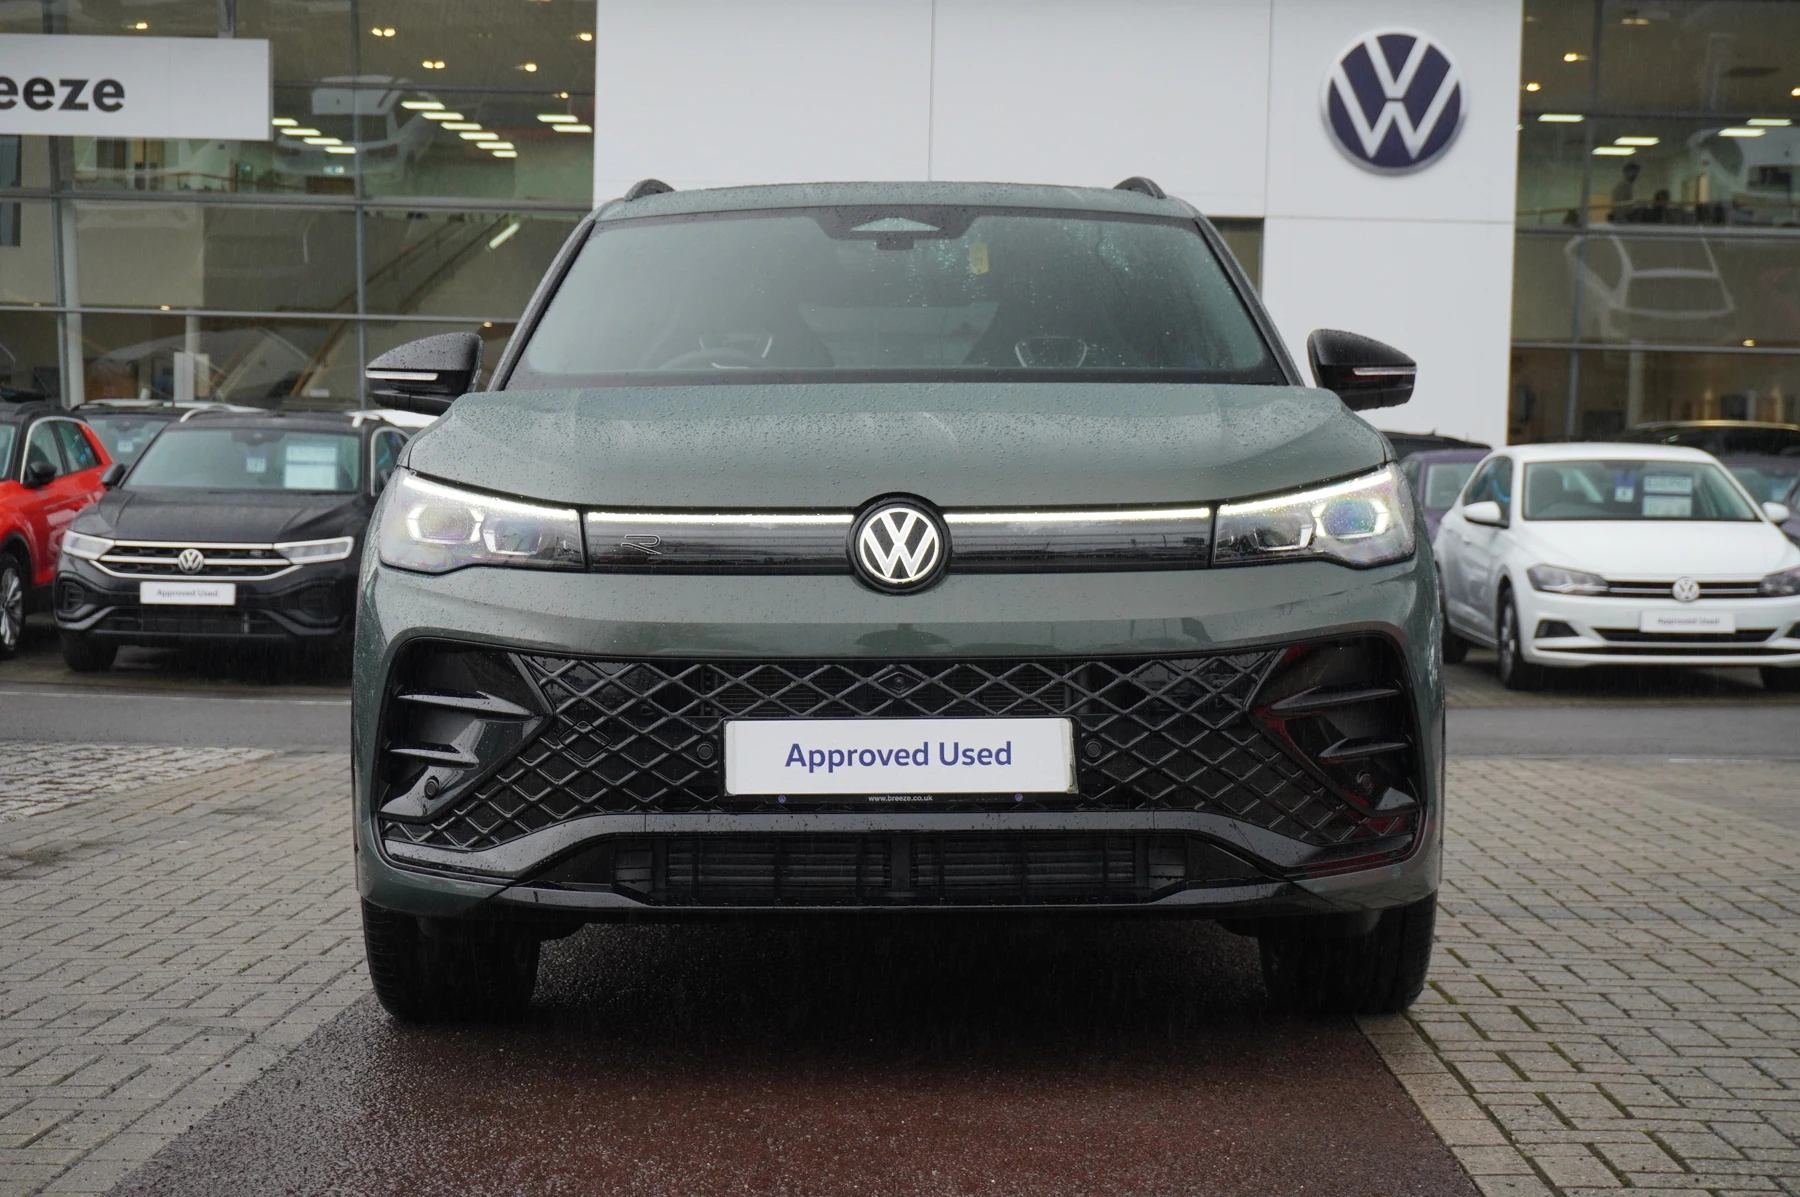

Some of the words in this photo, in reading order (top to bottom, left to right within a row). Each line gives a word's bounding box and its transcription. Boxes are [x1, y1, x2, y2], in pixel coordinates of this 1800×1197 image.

[1327, 29, 1463, 163] VW
[178, 549, 204, 574] VW
[860, 508, 939, 583] VW
[156, 589, 196, 598] Approved
[197, 589, 219, 597] Used
[785, 741, 929, 773] Approved
[939, 740, 1012, 766] Used
